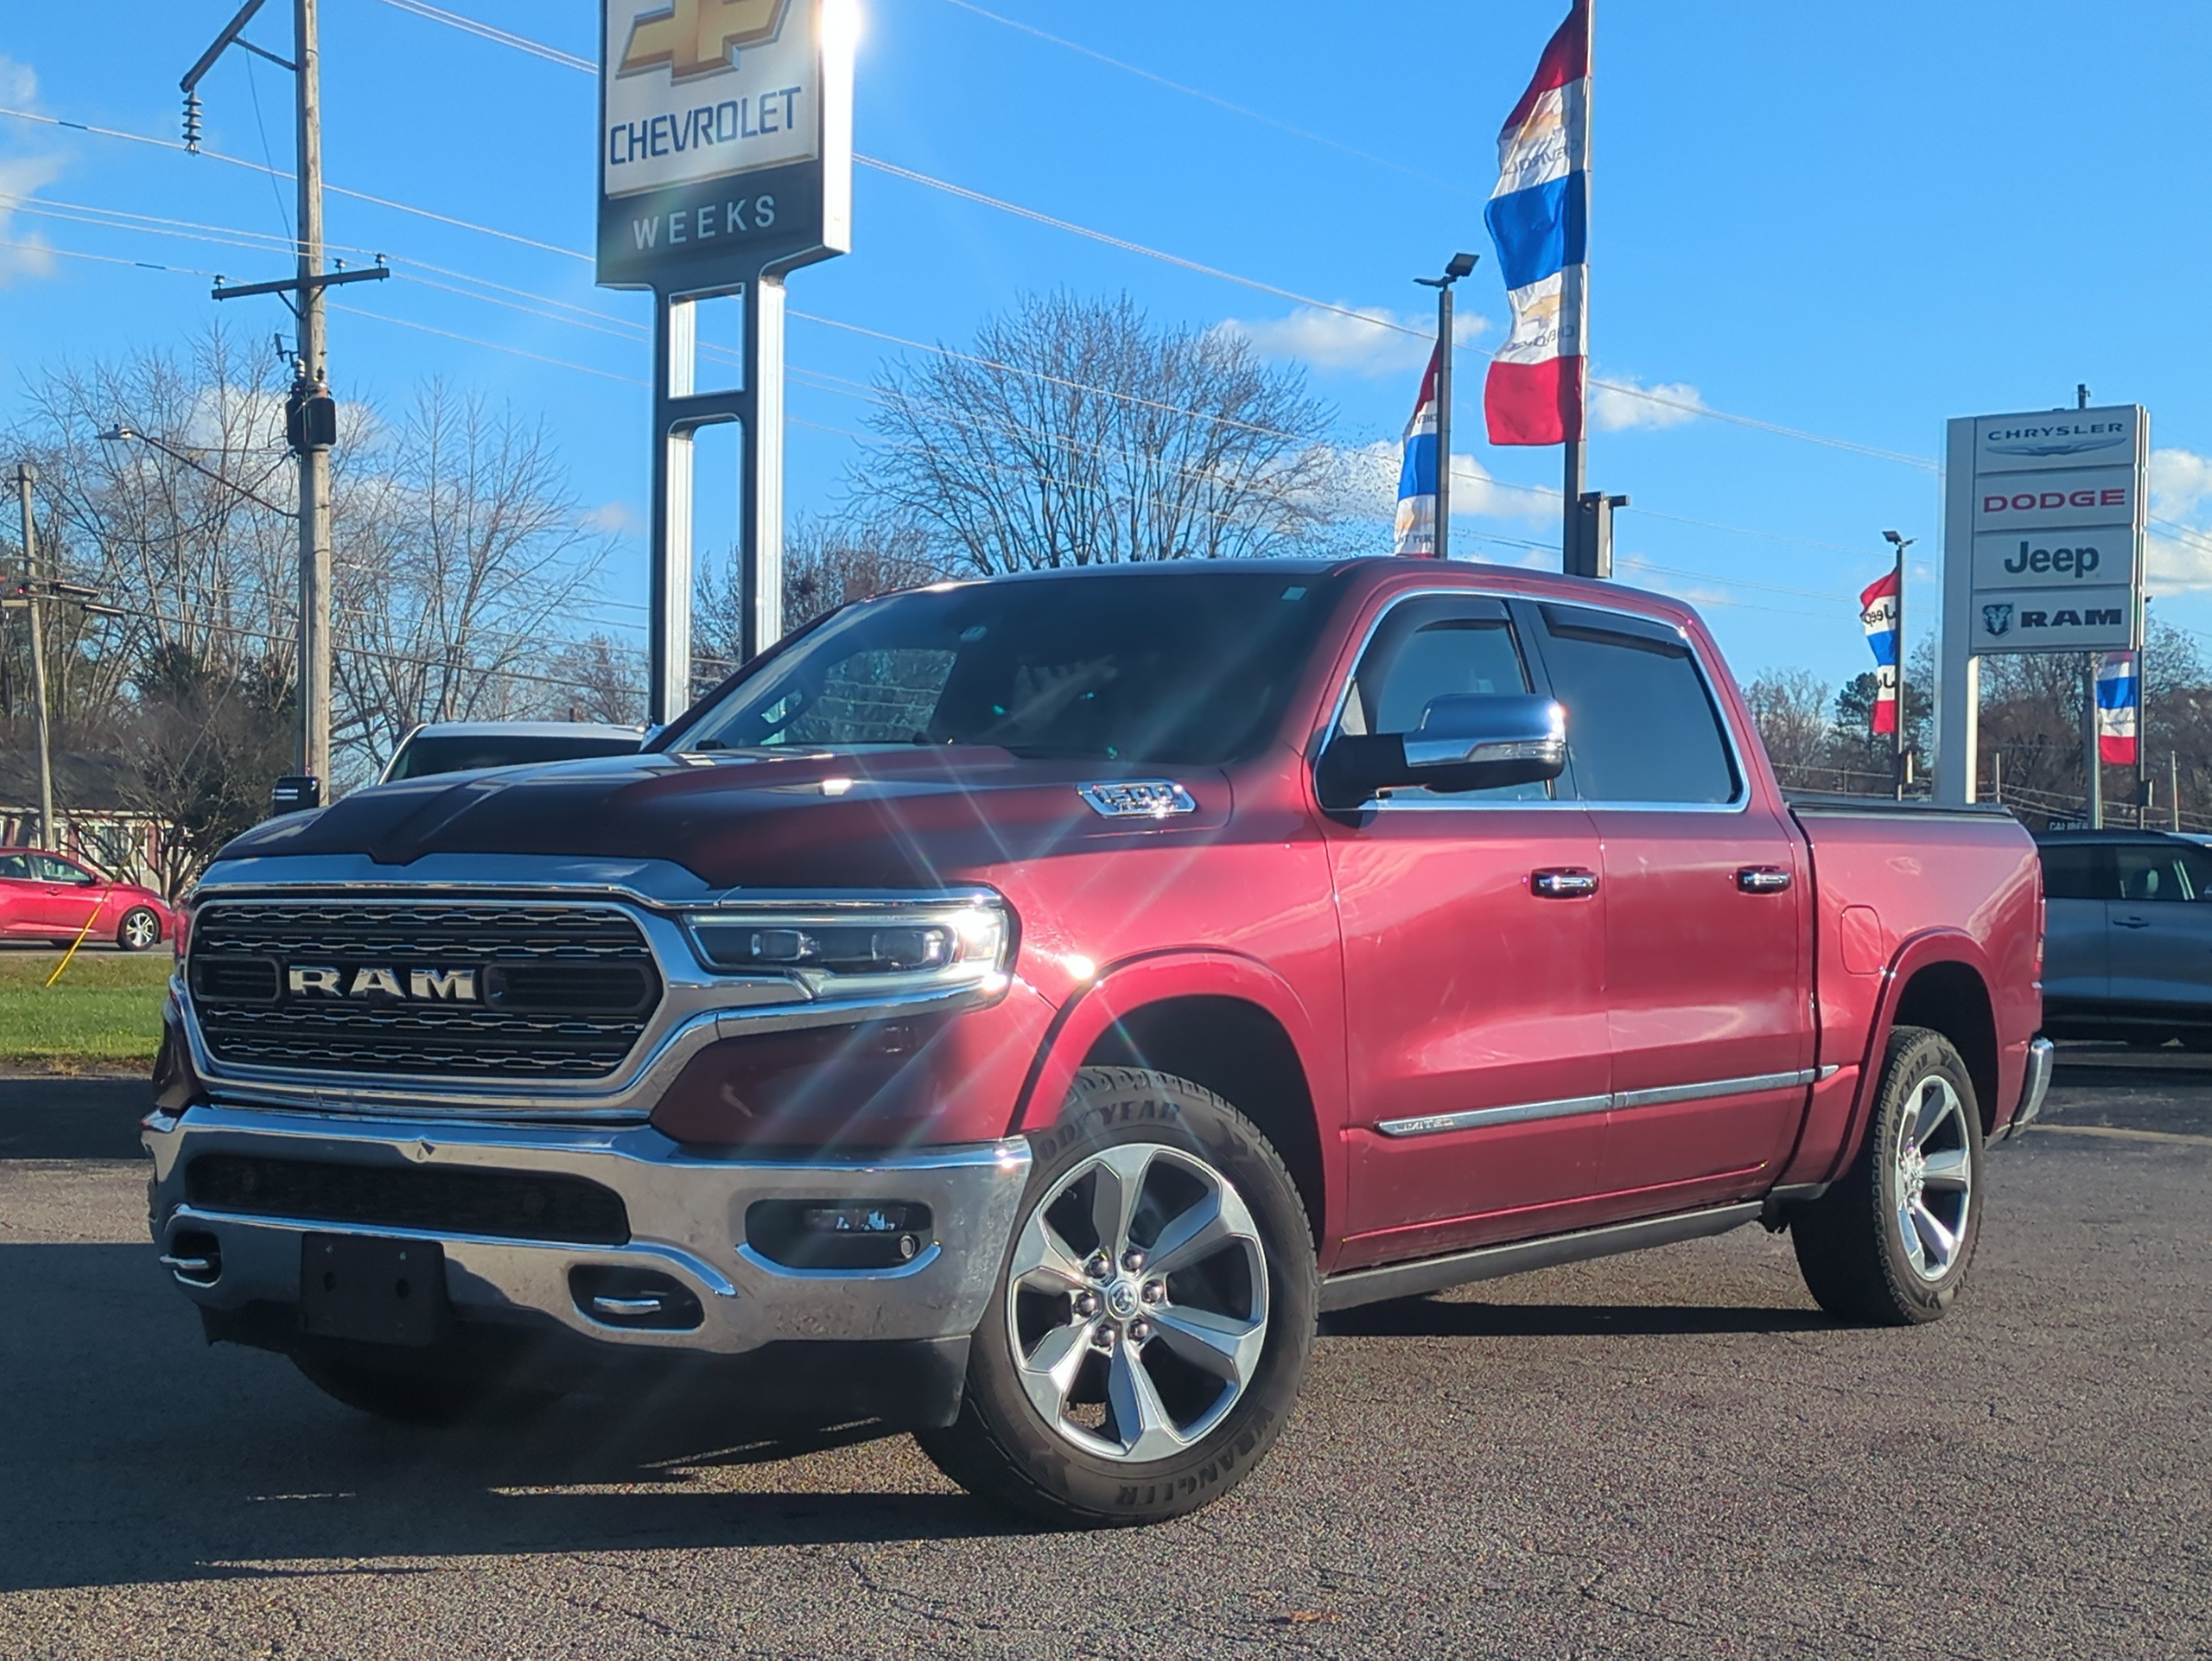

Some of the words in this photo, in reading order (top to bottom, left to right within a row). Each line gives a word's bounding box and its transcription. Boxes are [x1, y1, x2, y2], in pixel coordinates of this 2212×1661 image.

[610, 86, 801, 165] CHEVROLET
[633, 195, 775, 250] WEEKS
[1988, 422, 2124, 441] CHRYSLER
[1983, 489, 2125, 513] DODGE
[2004, 541, 2099, 578] Jeep
[2020, 609, 2123, 628] RAM
[289, 965, 477, 1000] RAM
